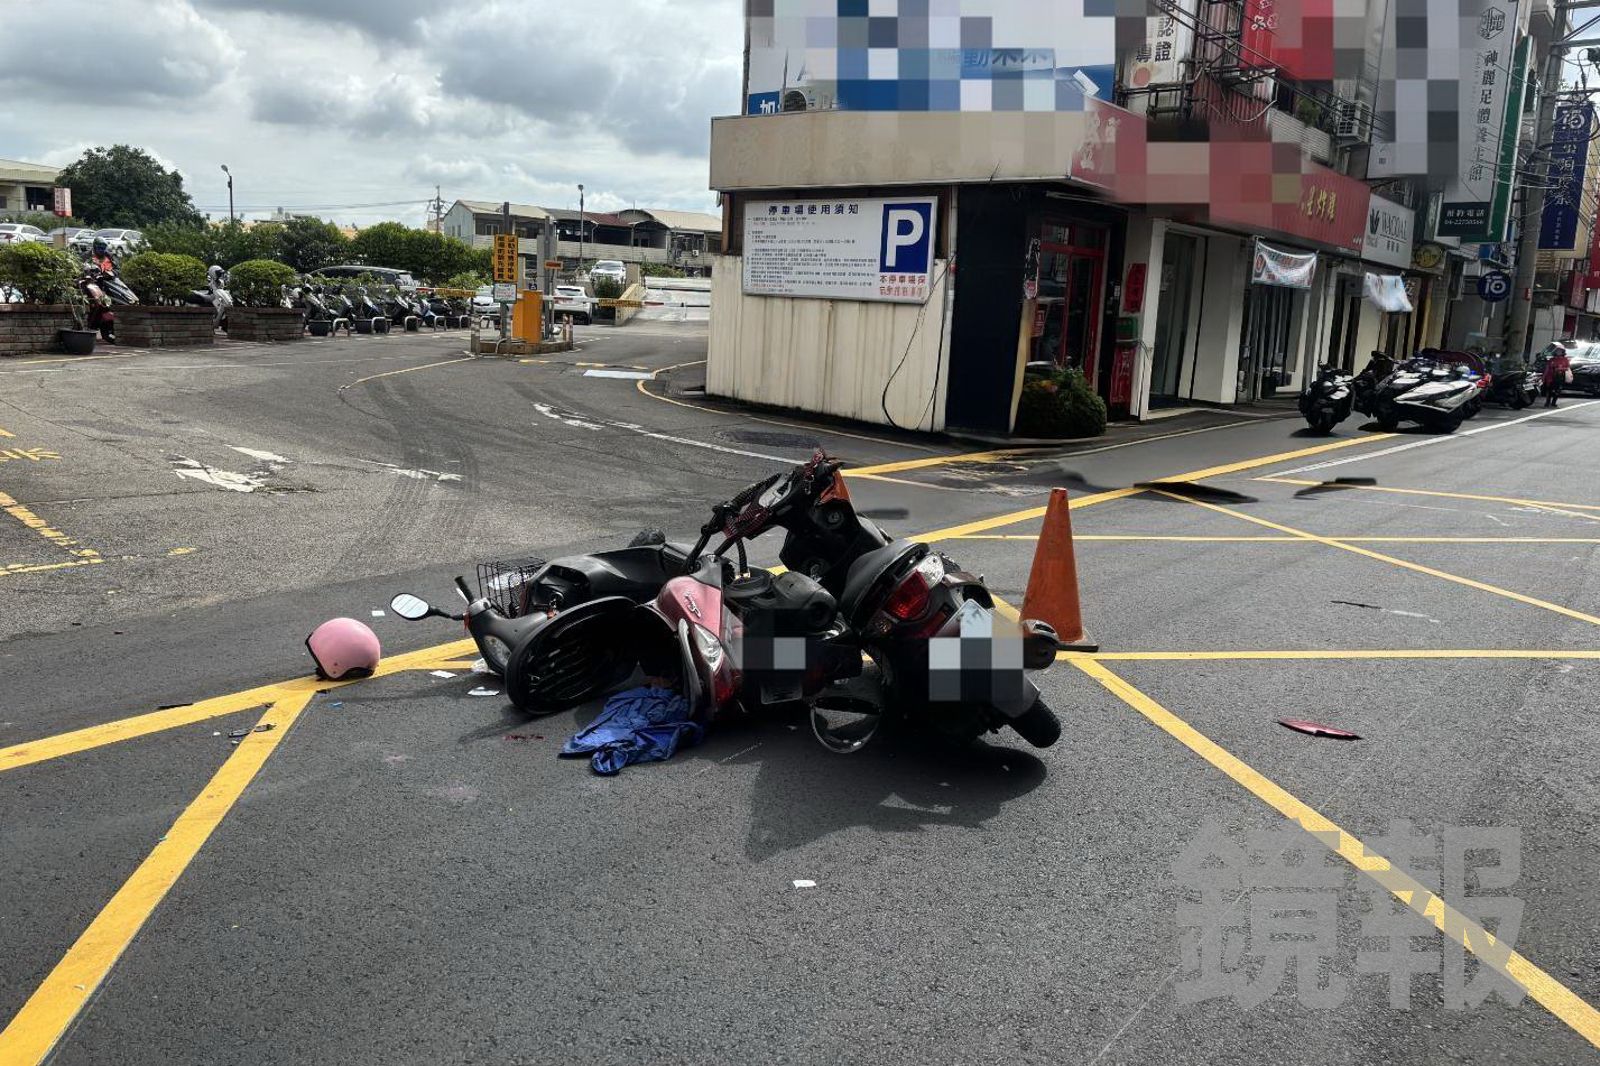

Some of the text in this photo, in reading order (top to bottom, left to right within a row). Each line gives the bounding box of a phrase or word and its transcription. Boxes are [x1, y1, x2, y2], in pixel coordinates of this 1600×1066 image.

[768, 203, 860, 216] 停車場使用須知
[885, 208, 924, 267] P
